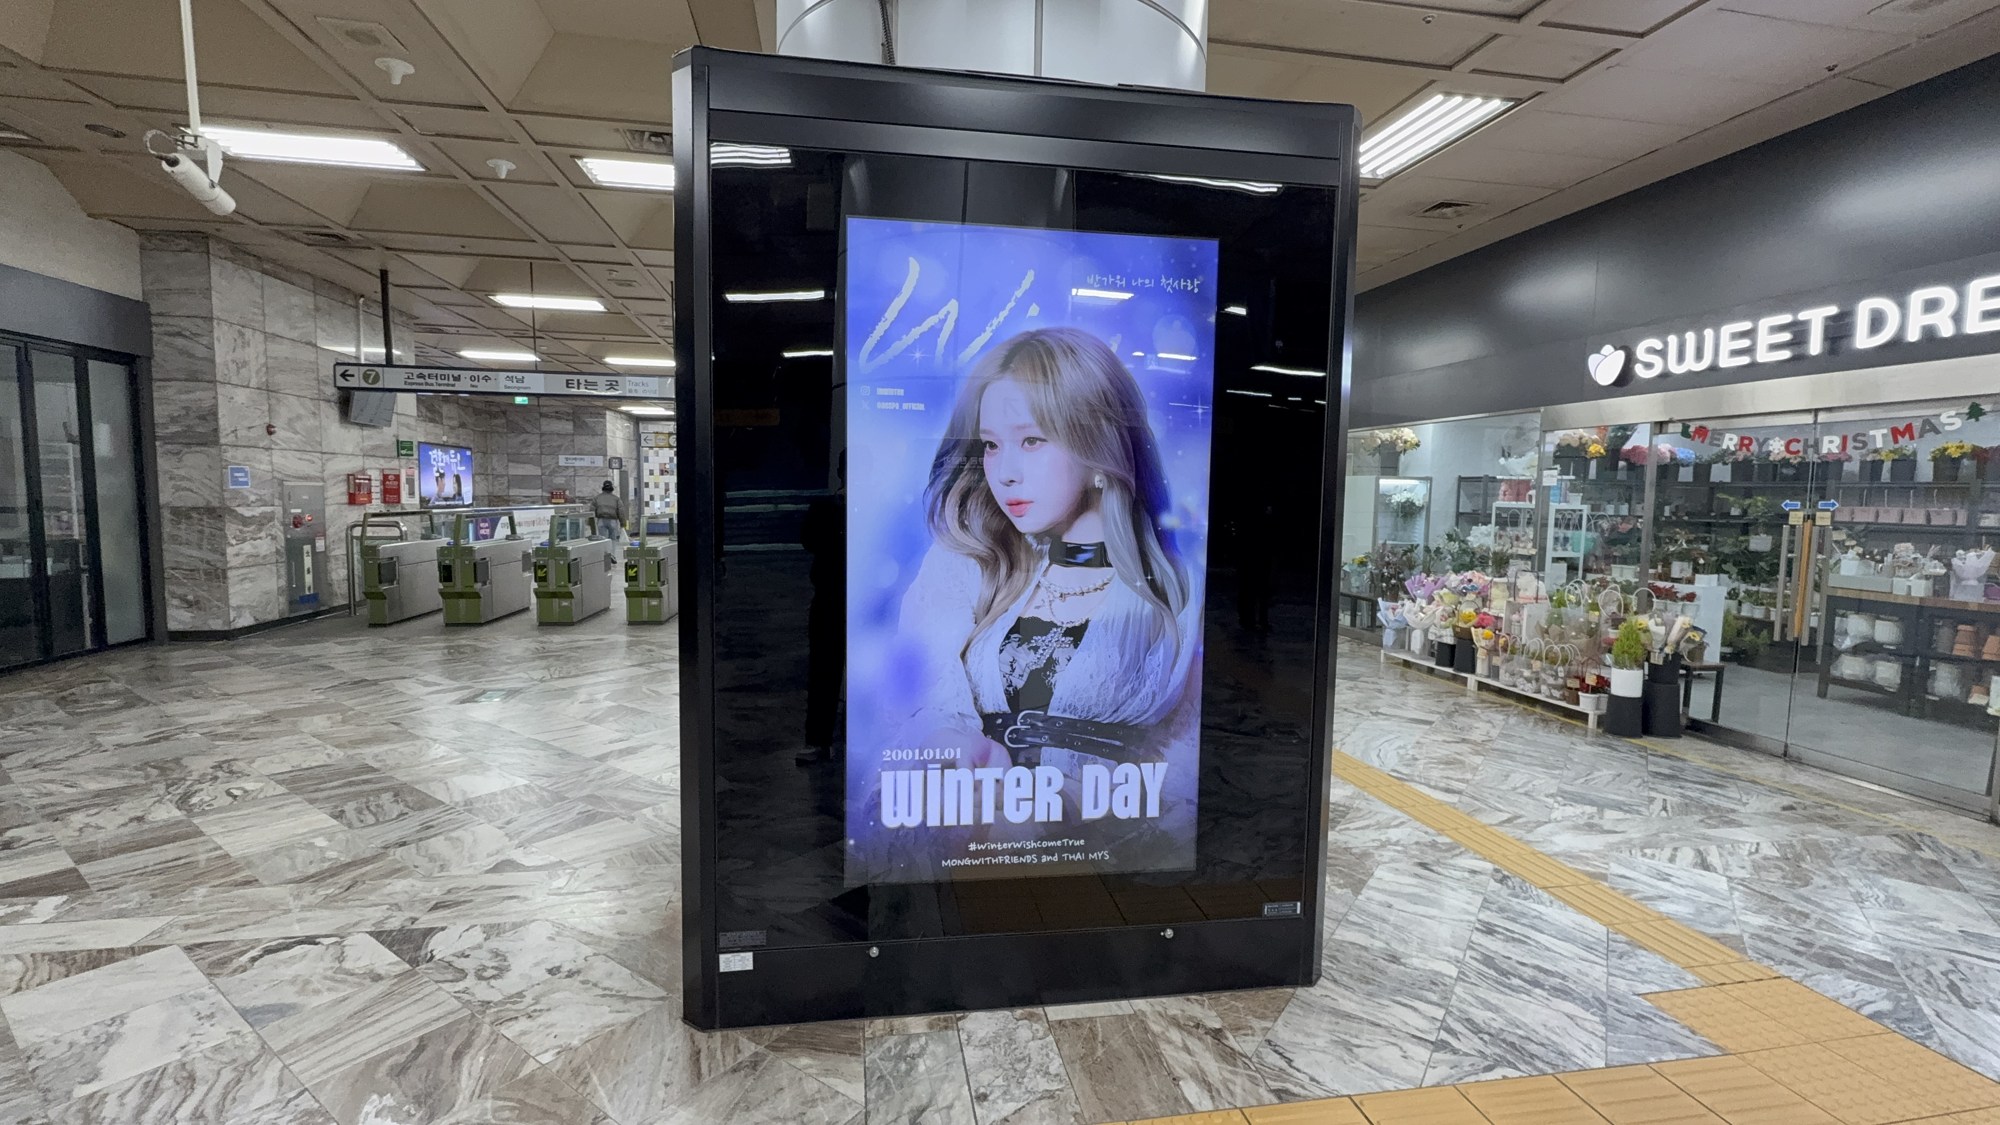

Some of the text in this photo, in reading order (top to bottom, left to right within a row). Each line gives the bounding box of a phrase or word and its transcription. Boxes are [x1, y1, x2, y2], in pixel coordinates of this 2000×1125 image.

[1086, 274, 1201, 294] 반가워 나의 첫사랑
[1633, 274, 2000, 380] SWEET DRE
[403, 371, 492, 384] 고속터미널 이수
[504, 375, 525, 384] 석남
[628, 380, 649, 388] Tracks
[565, 378, 598, 391] 타는
[605, 379, 620, 392] 곳
[1690, 411, 1962, 455] MERRY CHRISTMAS
[882, 747, 962, 761] 2001.01.01
[941, 850, 1110, 868] MONGWITHFRIENDS and THAI MYS
